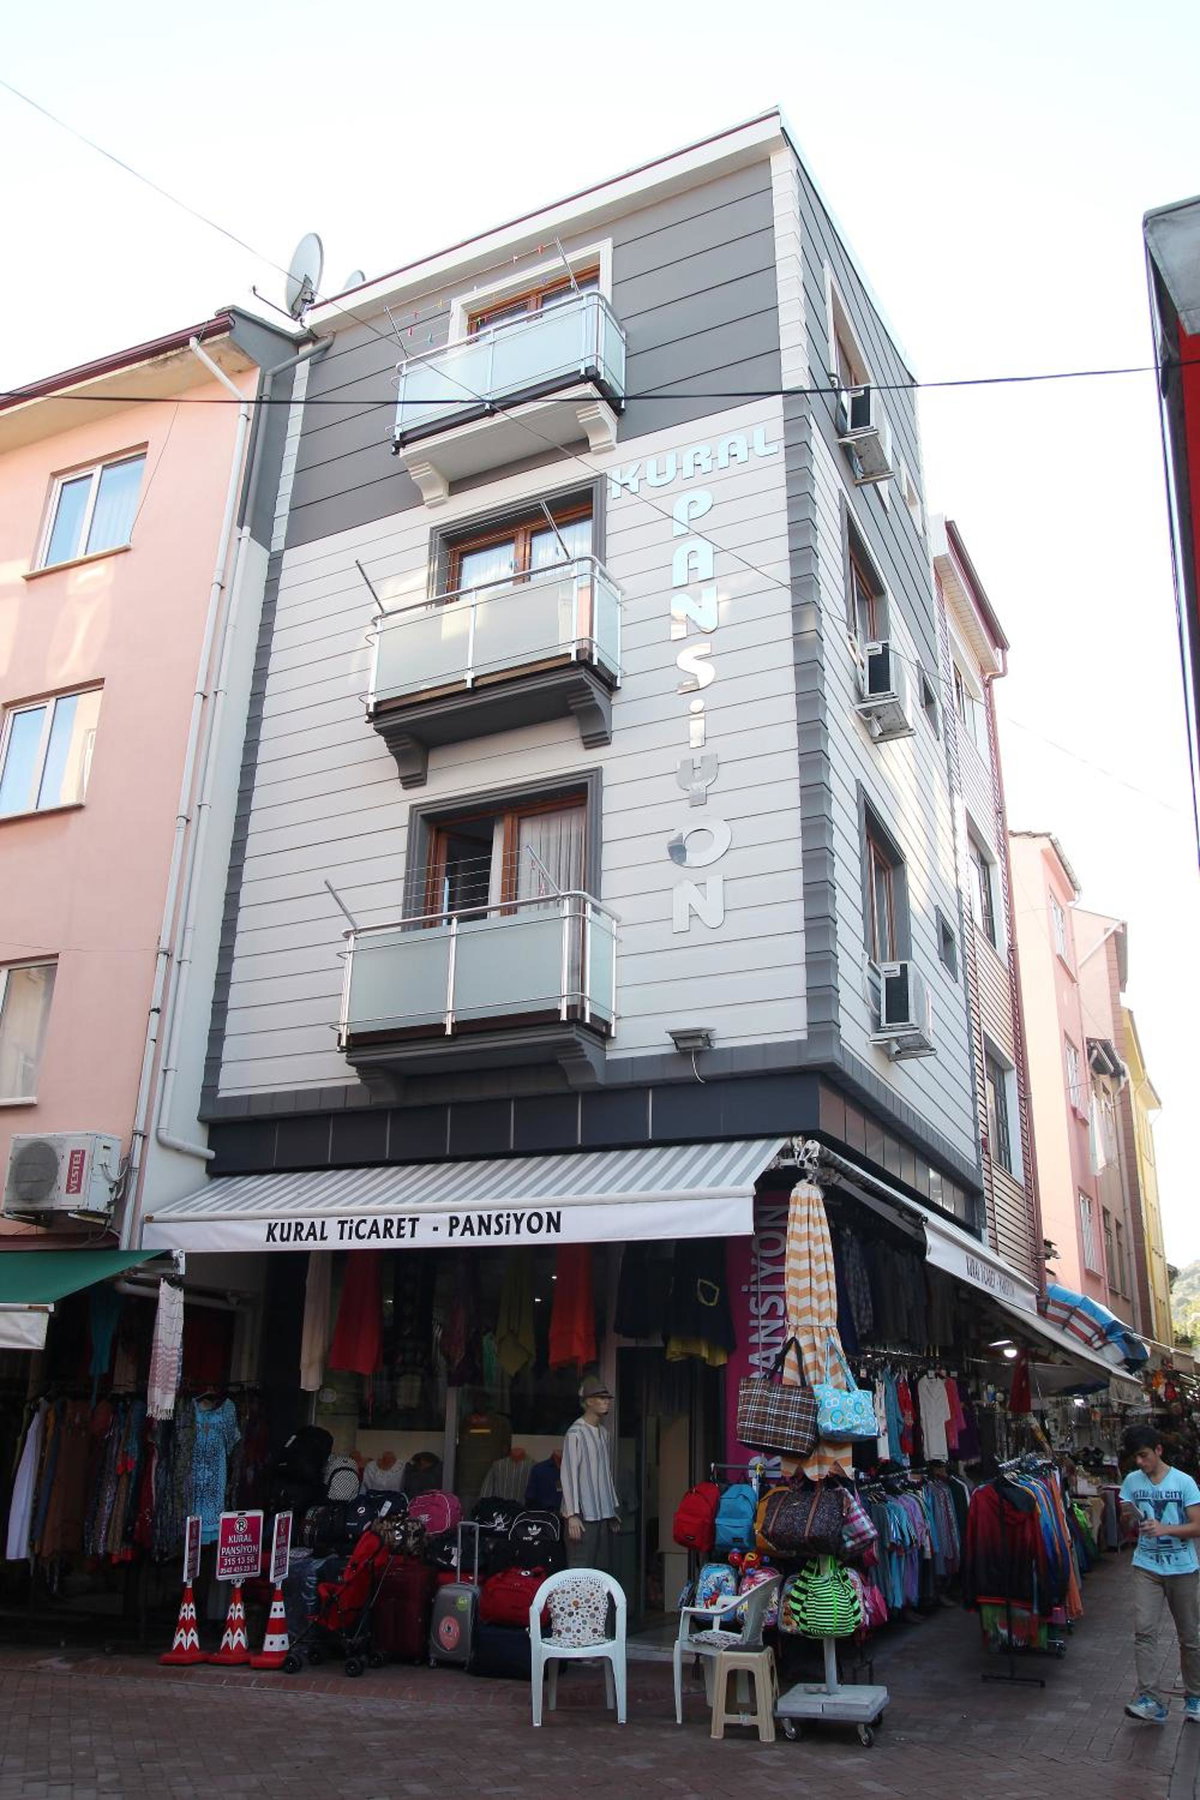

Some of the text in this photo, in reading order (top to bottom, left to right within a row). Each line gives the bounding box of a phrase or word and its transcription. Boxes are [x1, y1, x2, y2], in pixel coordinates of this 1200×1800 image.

[608, 427, 779, 499] KURAL
[69, 1150, 82, 1193] VESTEL
[265, 1220, 328, 1242] KURAL
[228, 1534, 252, 1543] KURAL
